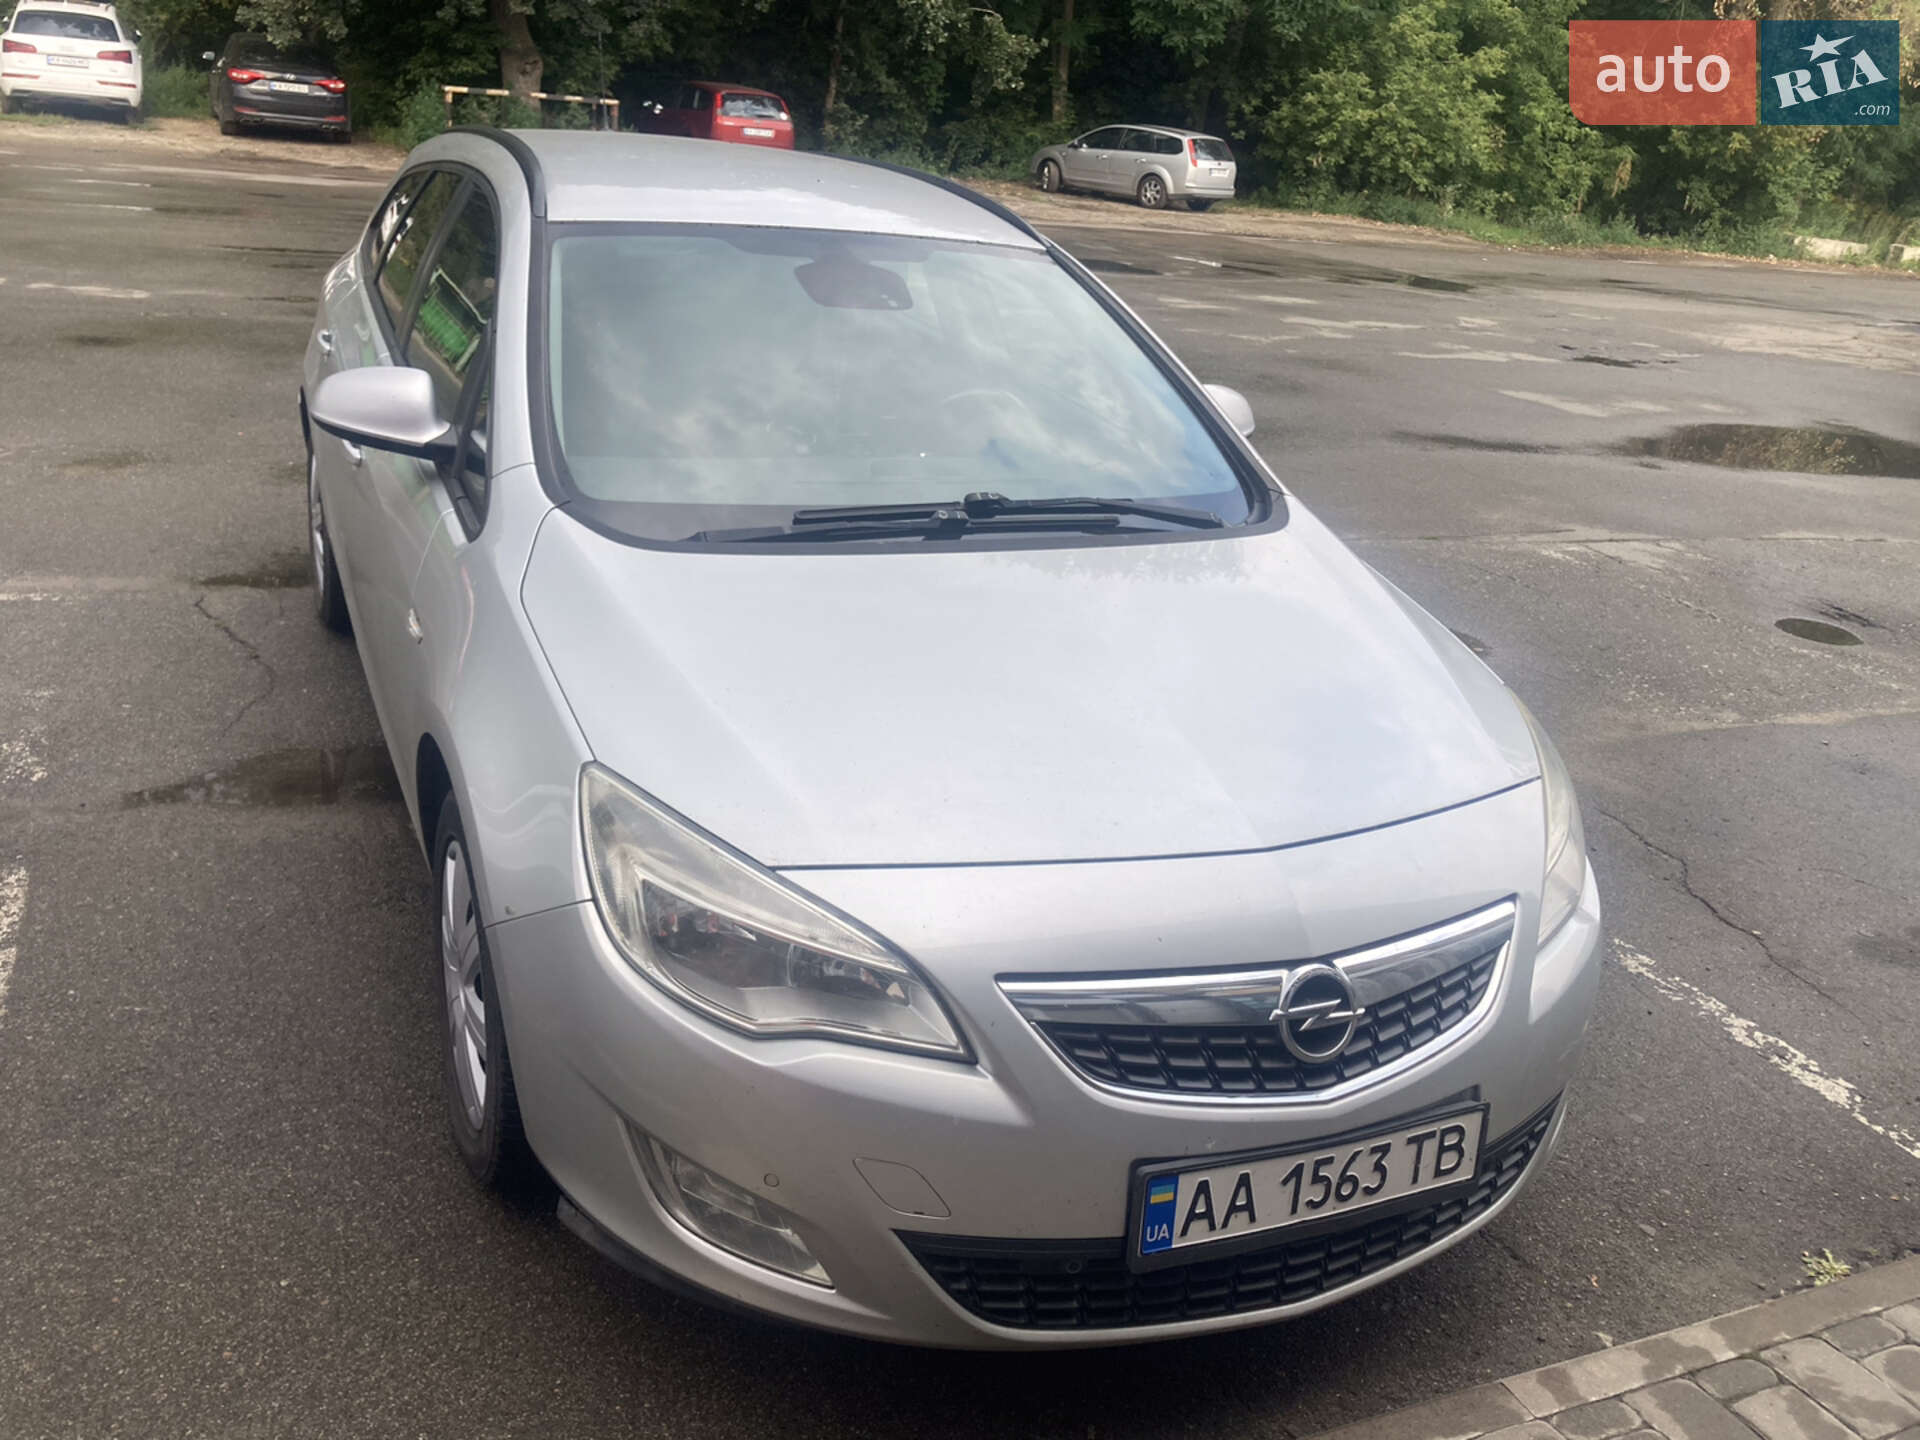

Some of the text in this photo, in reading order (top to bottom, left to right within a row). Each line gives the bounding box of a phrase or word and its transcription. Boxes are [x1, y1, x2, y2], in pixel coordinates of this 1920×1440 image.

[1179, 1123, 1467, 1238] AA 1563 TB
[1145, 1223, 1170, 1243] UA
